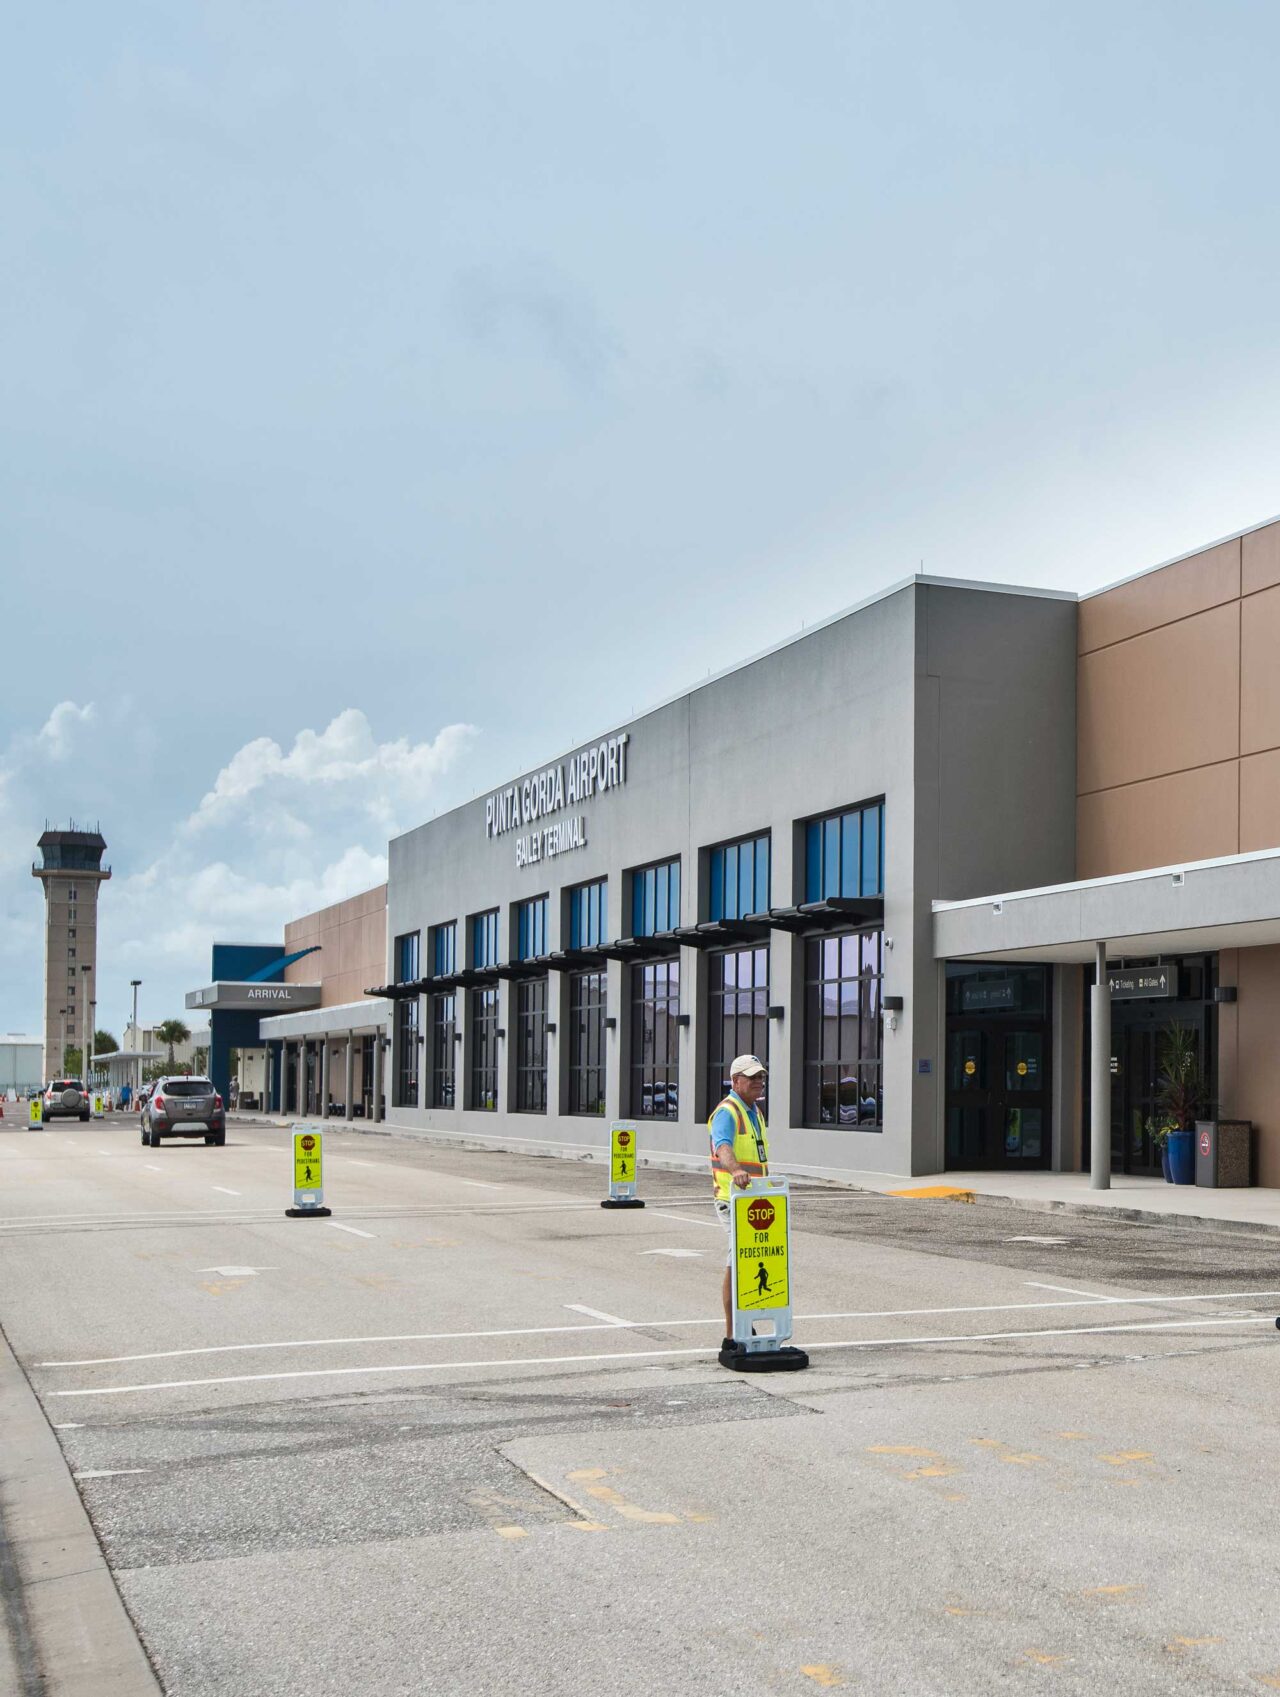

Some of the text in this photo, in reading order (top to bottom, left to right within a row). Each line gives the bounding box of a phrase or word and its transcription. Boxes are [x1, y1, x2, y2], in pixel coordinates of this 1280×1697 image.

[486, 732, 629, 838] PUNTA GORDA AIRPORT
[516, 815, 586, 867] BAILEY TERMINAL
[247, 989, 291, 999] ARRIVAL
[301, 1139, 315, 1147] STOP
[748, 1208, 775, 1221] STOP
[754, 1232, 769, 1243] FOR
[739, 1246, 785, 1258] PEDESTRIANS
